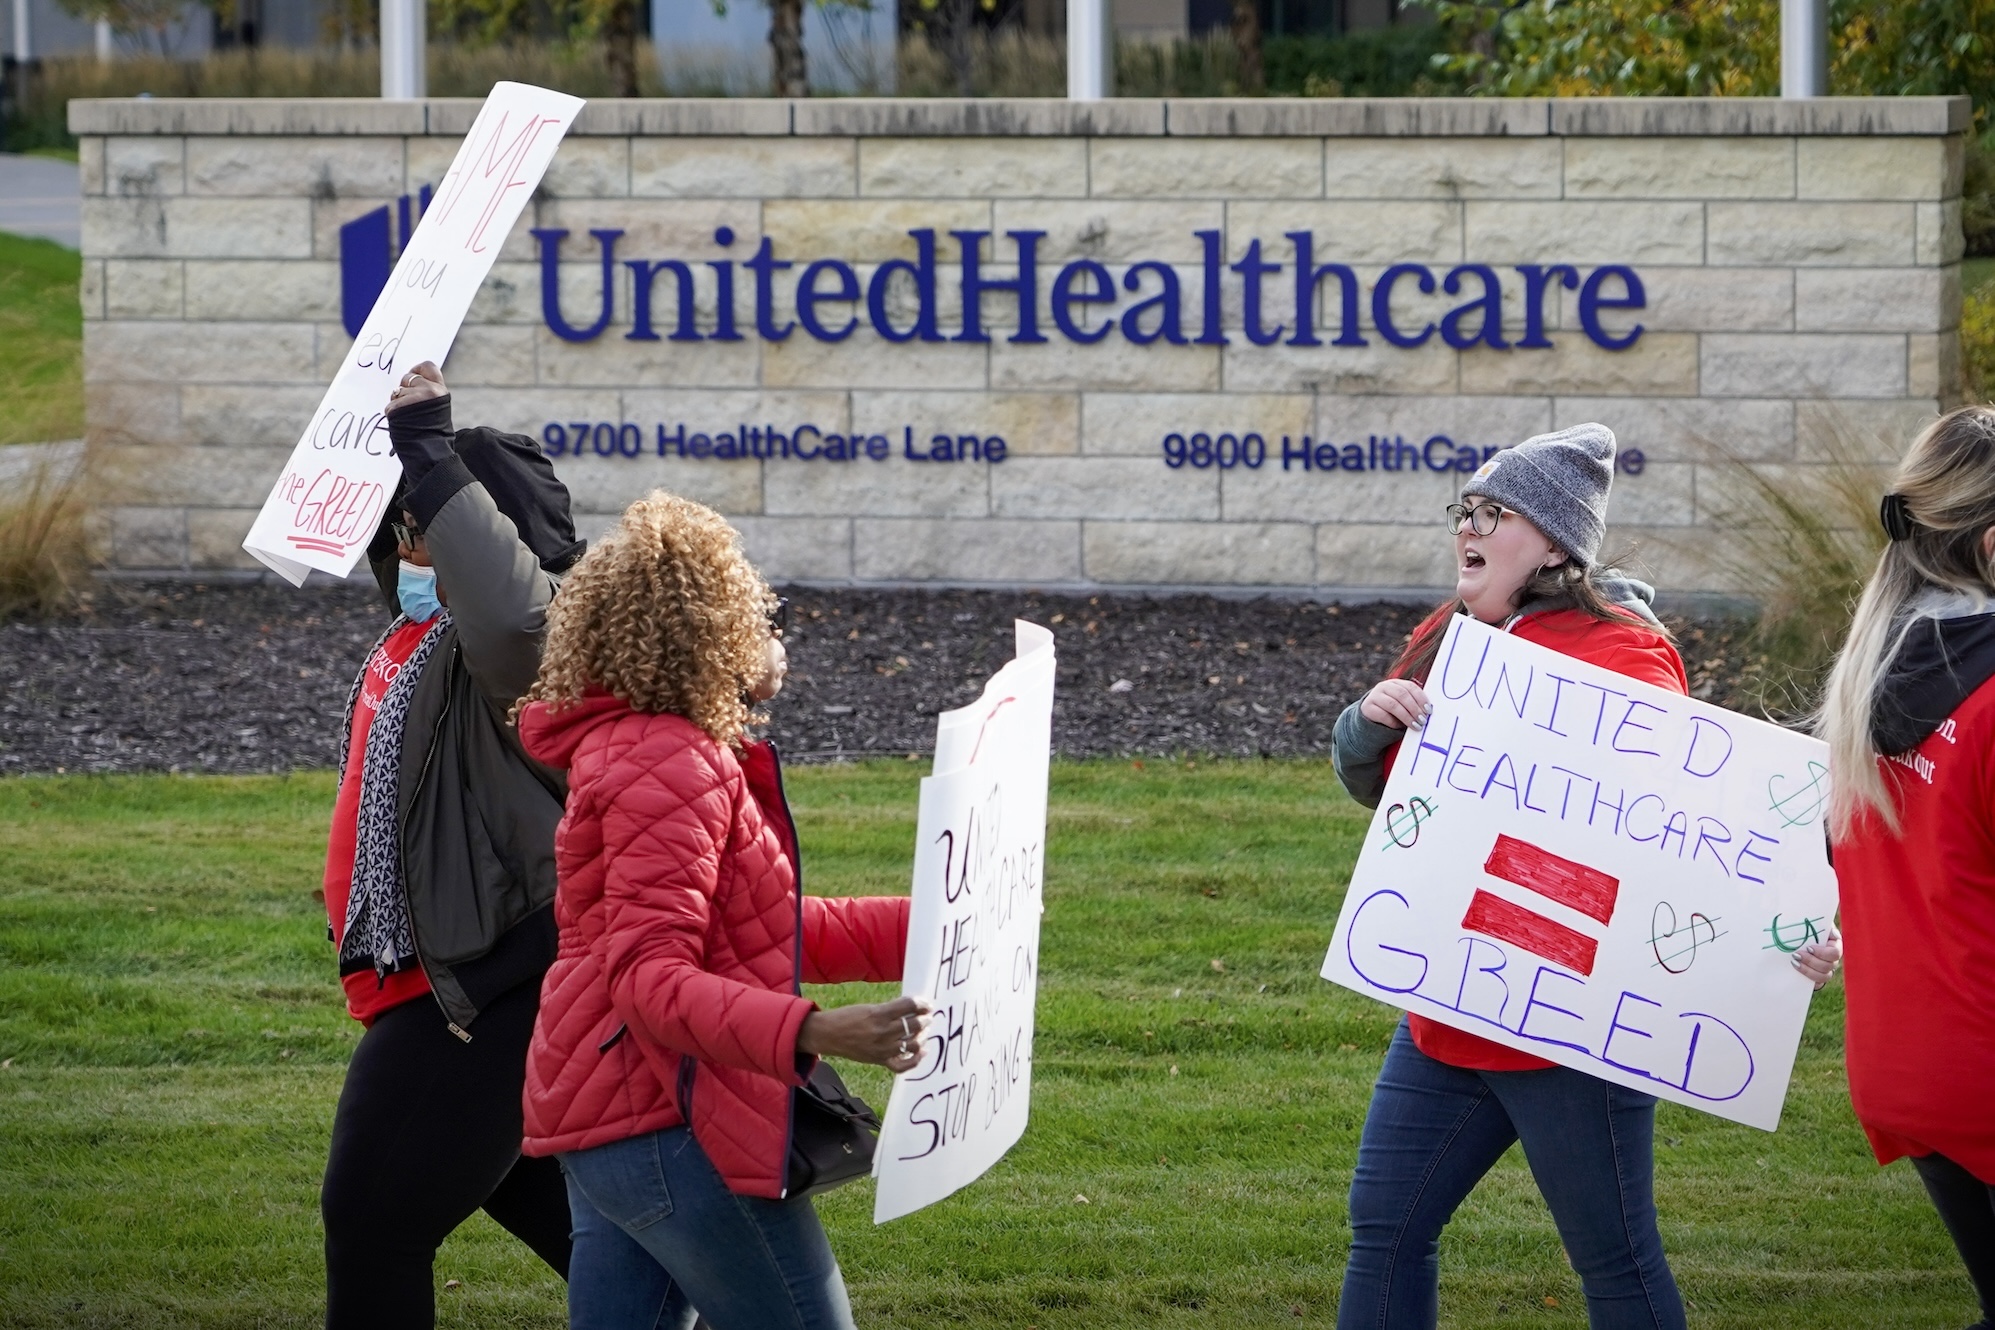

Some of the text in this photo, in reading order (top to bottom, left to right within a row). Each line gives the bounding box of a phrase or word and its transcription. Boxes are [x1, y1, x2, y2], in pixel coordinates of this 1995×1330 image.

[529, 226, 1647, 351] UnitedHealthcare
[542, 423, 1008, 464] 9700 HealthCare Lane
[1163, 433, 1515, 475] 9800 HealthCar
[294, 469, 384, 546] GREED
[1441, 621, 1733, 778] UNITED
[1410, 716, 1780, 884] HEALTHCARE
[1347, 889, 1754, 1100] GREED
[898, 1073, 977, 1161] STOP
